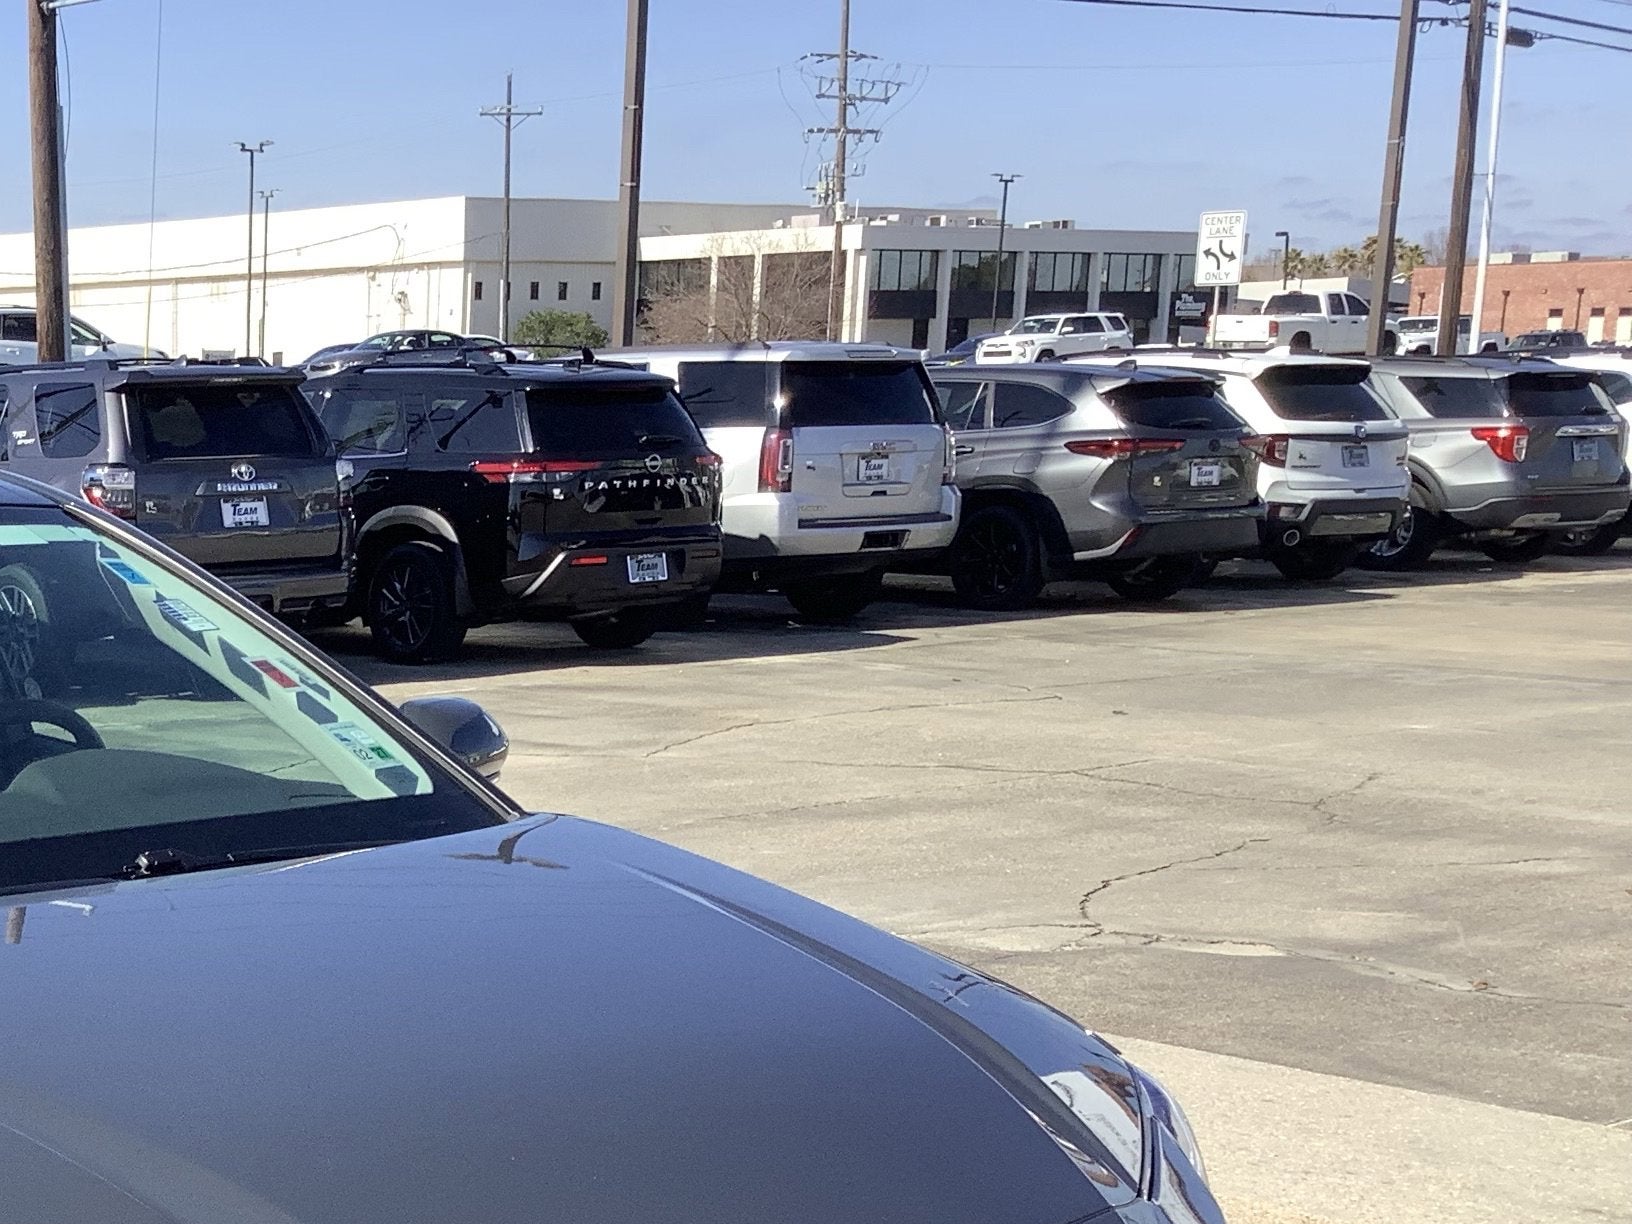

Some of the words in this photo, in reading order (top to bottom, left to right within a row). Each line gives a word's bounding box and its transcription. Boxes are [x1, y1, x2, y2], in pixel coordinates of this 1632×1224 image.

[1204, 215, 1241, 226] CENTER
[1209, 226, 1234, 236] LANE
[1204, 271, 1231, 281] ONLY
[584, 476, 709, 490] PATHFINDER
[231, 504, 258, 516] TEAM
